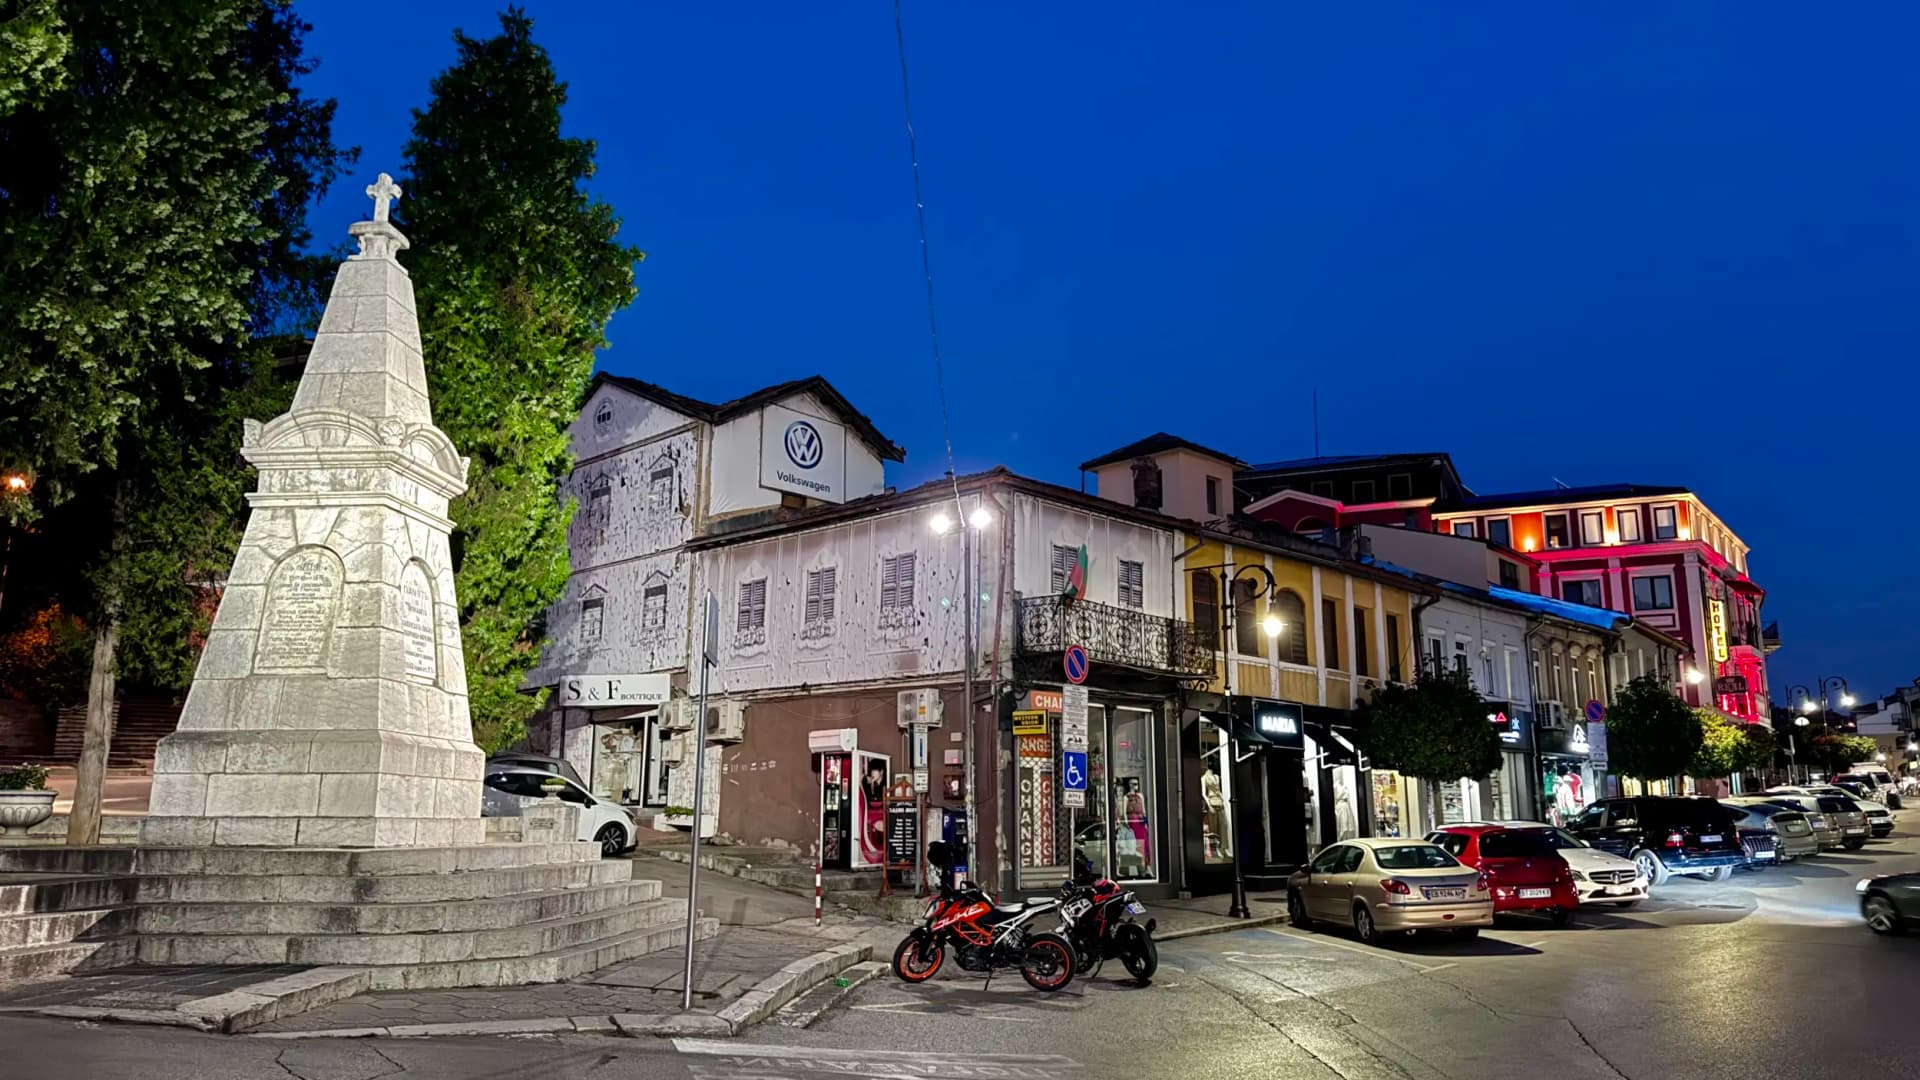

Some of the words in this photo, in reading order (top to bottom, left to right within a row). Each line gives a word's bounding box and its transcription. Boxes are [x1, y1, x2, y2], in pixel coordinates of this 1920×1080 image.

[777, 470, 831, 493] Volkswagen
[1711, 602, 1725, 658] HOTEL
[567, 680, 581, 701] S
[588, 687, 600, 701] &
[606, 680, 621, 700] F
[621, 693, 662, 701] BOUTIQUE
